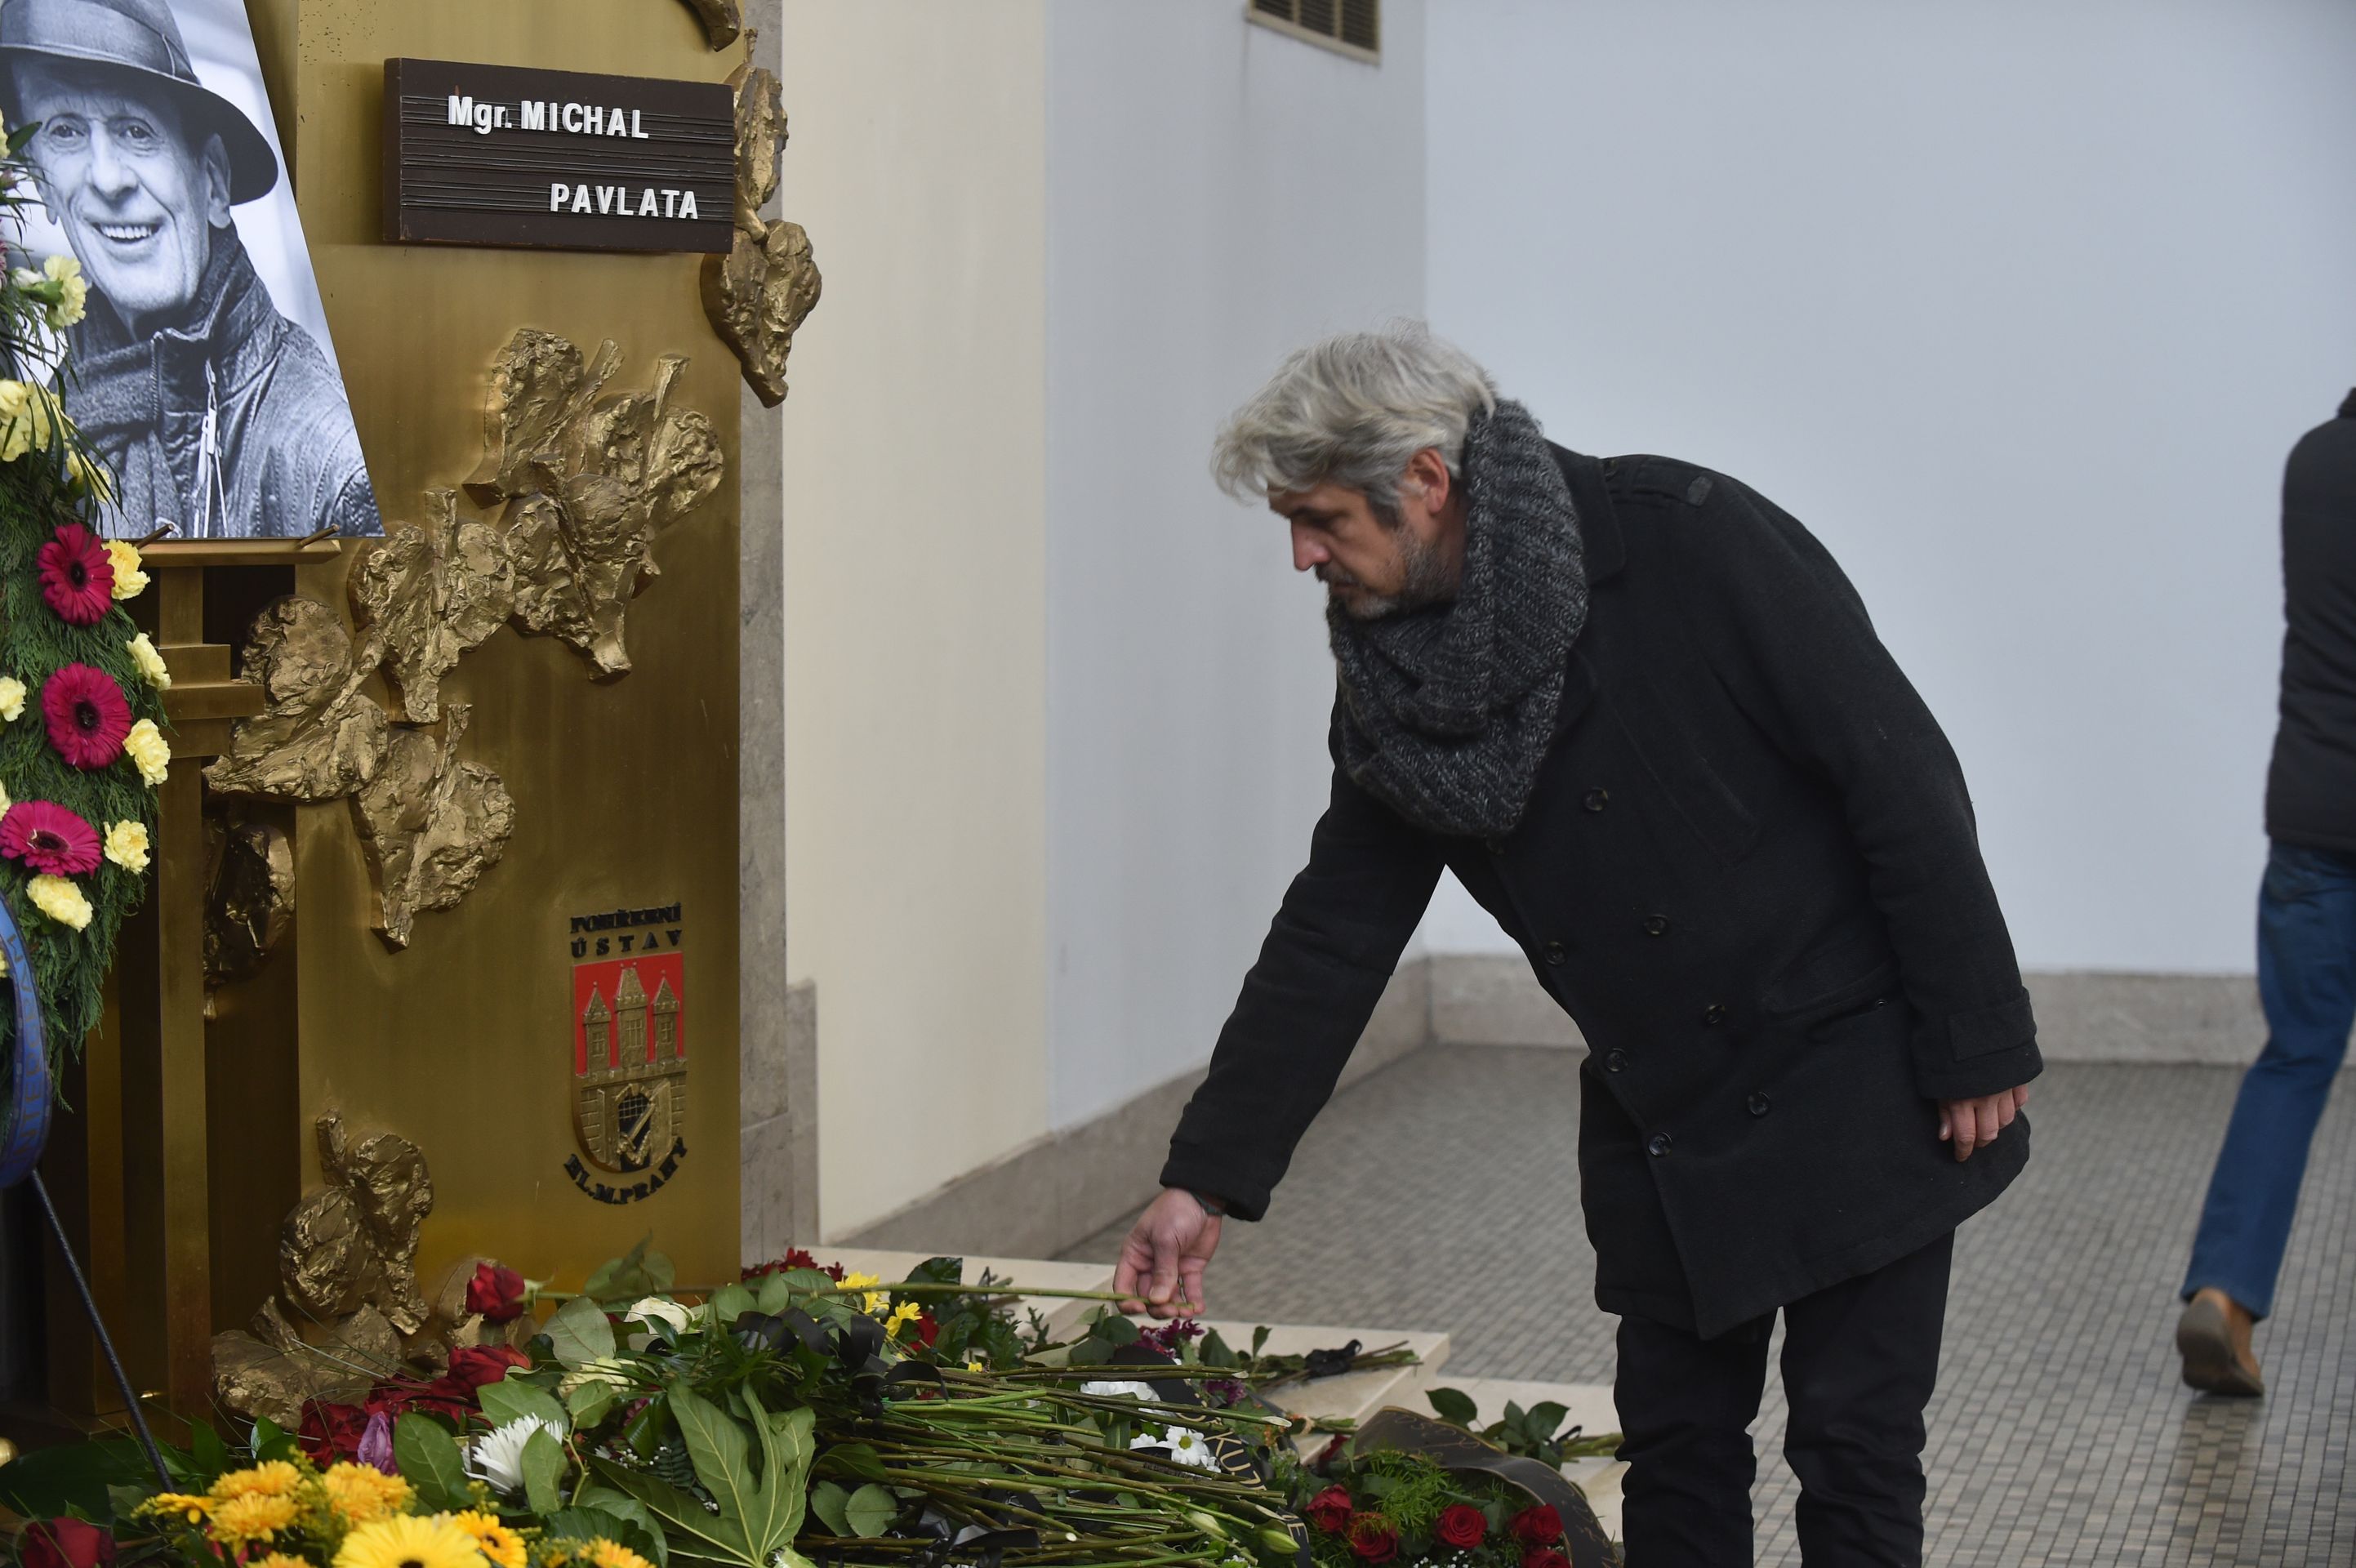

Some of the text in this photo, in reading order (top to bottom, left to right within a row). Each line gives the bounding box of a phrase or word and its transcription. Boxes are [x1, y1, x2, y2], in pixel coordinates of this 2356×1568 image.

[448, 95, 649, 140] Mgr. MICHAL
[550, 182, 699, 220] PAVLATA
[570, 928, 683, 958] ÚSTAV
